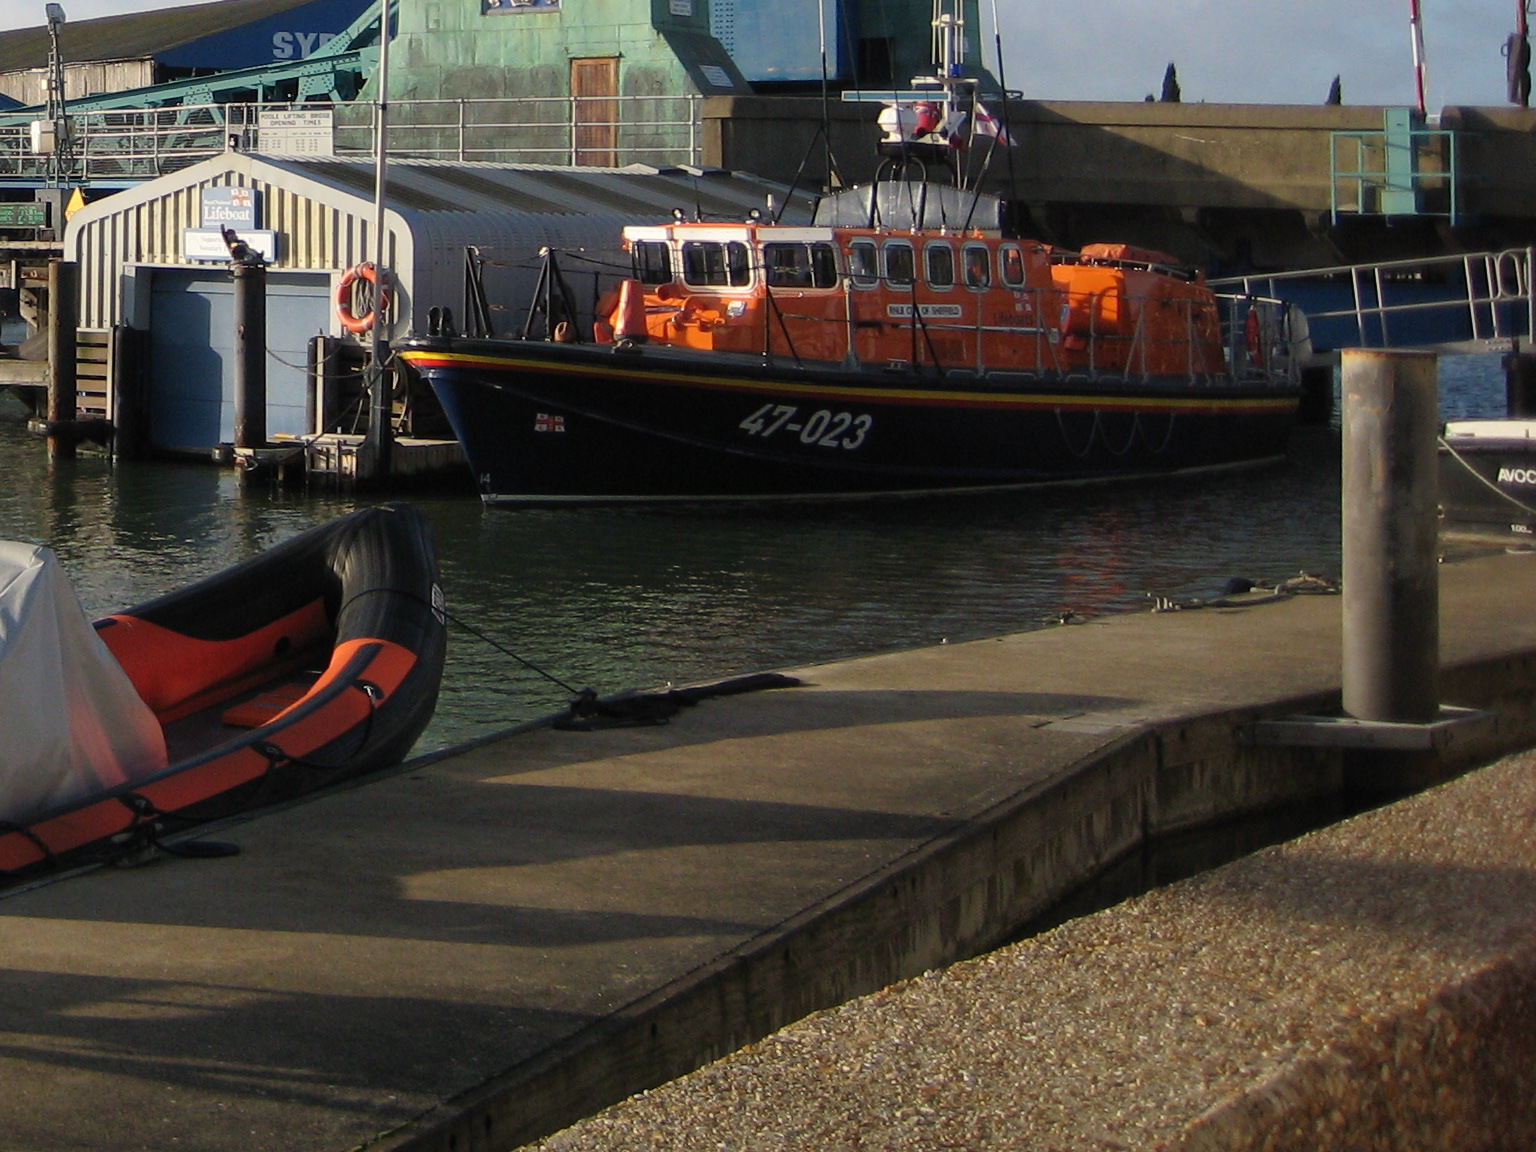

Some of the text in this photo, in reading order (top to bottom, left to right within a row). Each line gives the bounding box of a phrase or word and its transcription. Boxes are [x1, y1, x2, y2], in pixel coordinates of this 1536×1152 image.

[204, 206, 250, 221] Lifeboat
[738, 403, 873, 450] 47-023
[480, 472, 491, 484] 14
